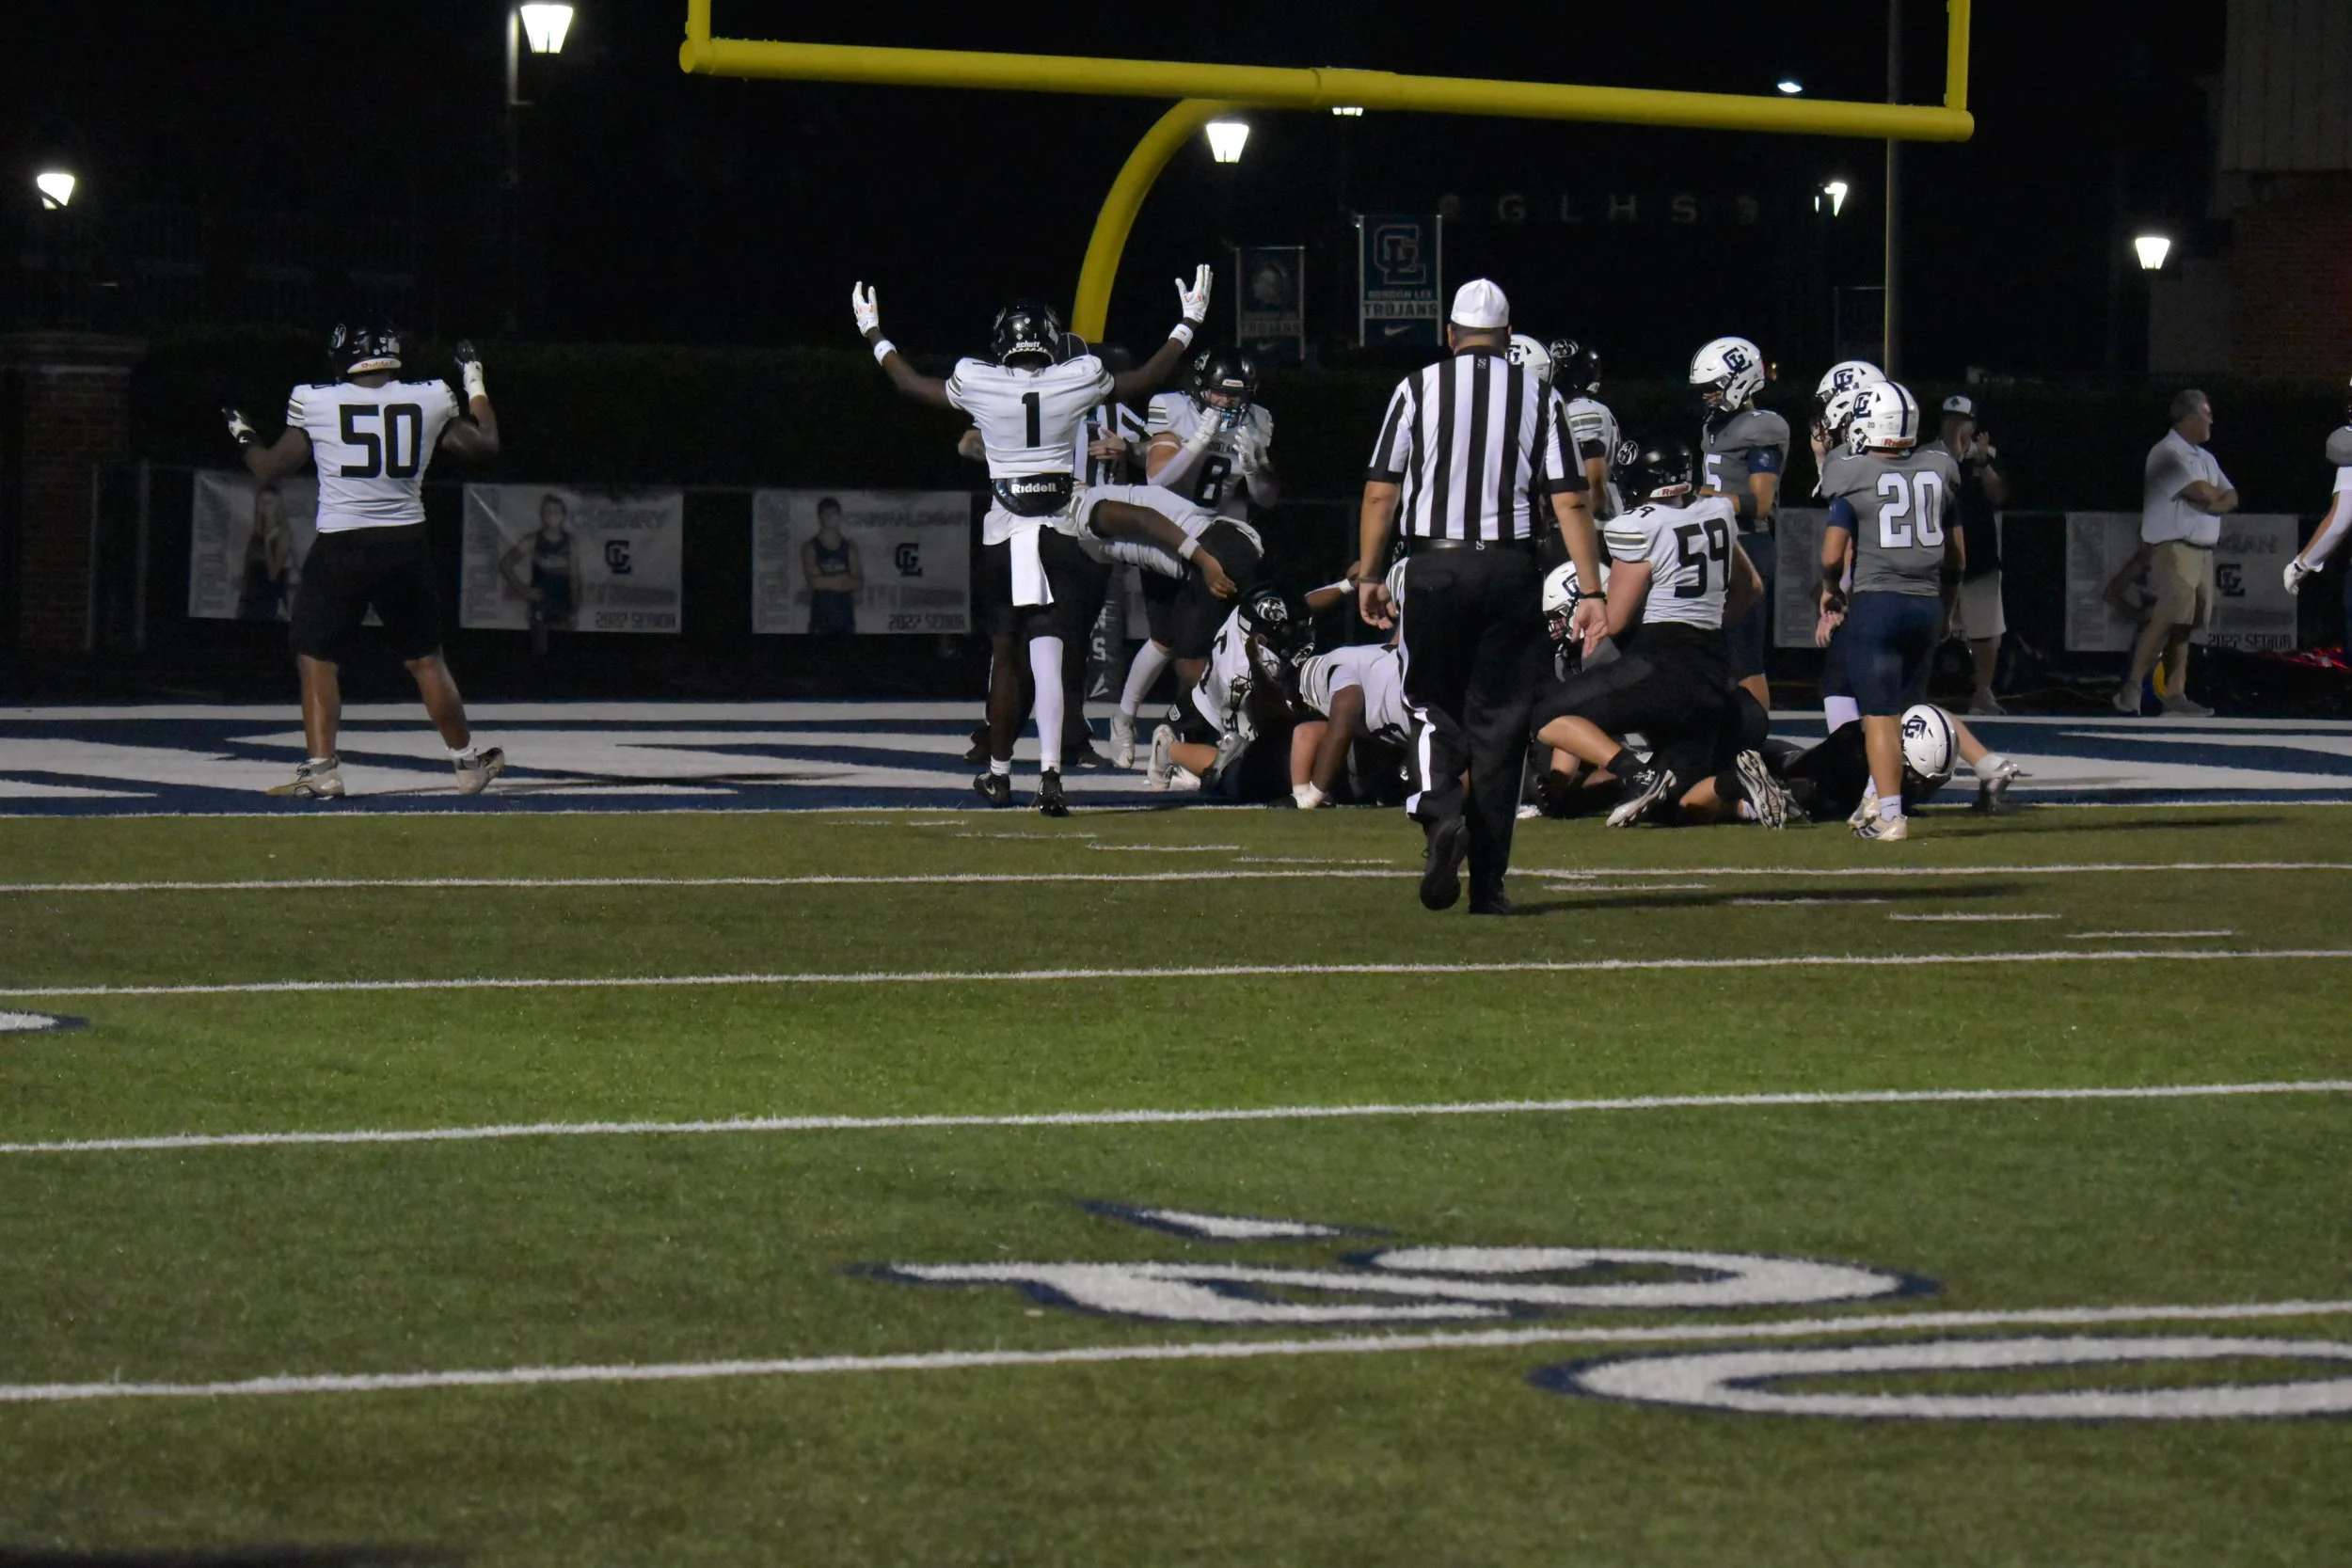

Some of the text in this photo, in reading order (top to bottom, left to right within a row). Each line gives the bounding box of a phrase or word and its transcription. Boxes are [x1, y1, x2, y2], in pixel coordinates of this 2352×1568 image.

[1365, 303, 1438, 317] TROJANS
[340, 403, 422, 479] 50
[1022, 391, 1041, 448] 1
[1010, 483, 1057, 495] Riddell
[1194, 455, 1232, 507] 8
[1876, 470, 1946, 548] 20
[1673, 517, 1730, 598] 59
